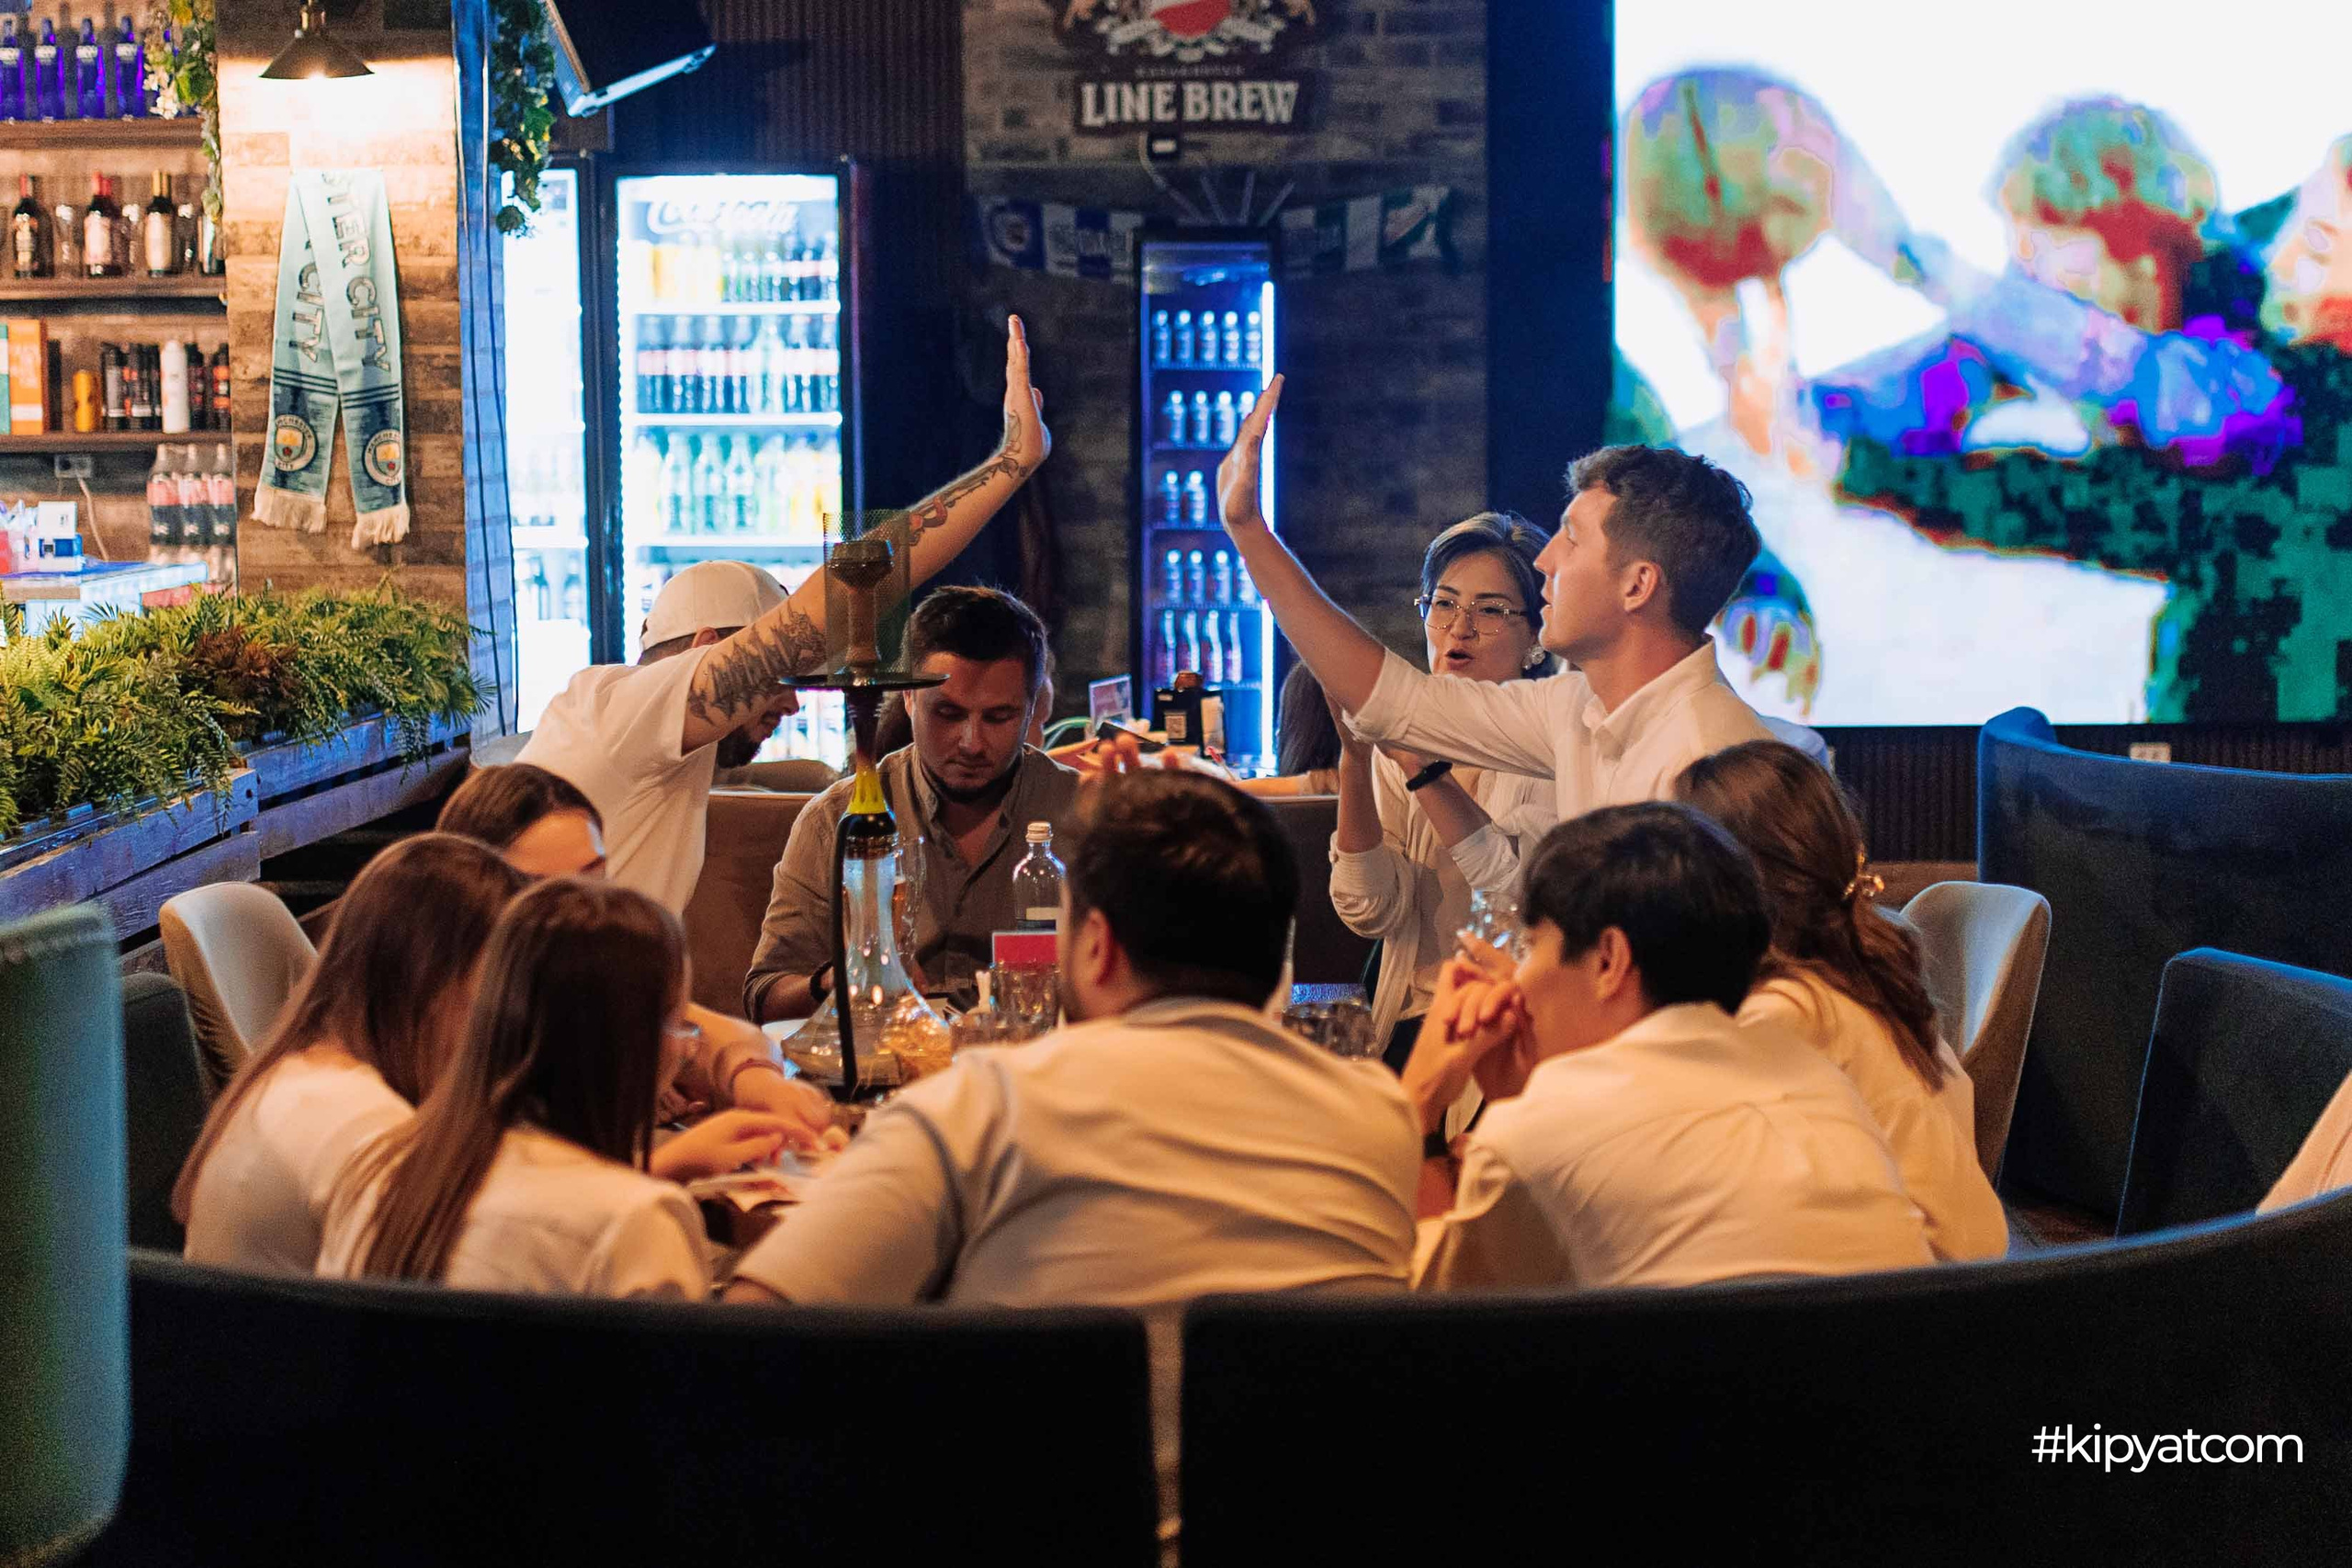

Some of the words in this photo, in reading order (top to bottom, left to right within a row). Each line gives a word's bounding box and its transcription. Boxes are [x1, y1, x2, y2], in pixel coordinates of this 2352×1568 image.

[1080, 81, 1177, 127] LINE
[1182, 81, 1300, 124] BREW
[346, 276, 390, 371] CITY
